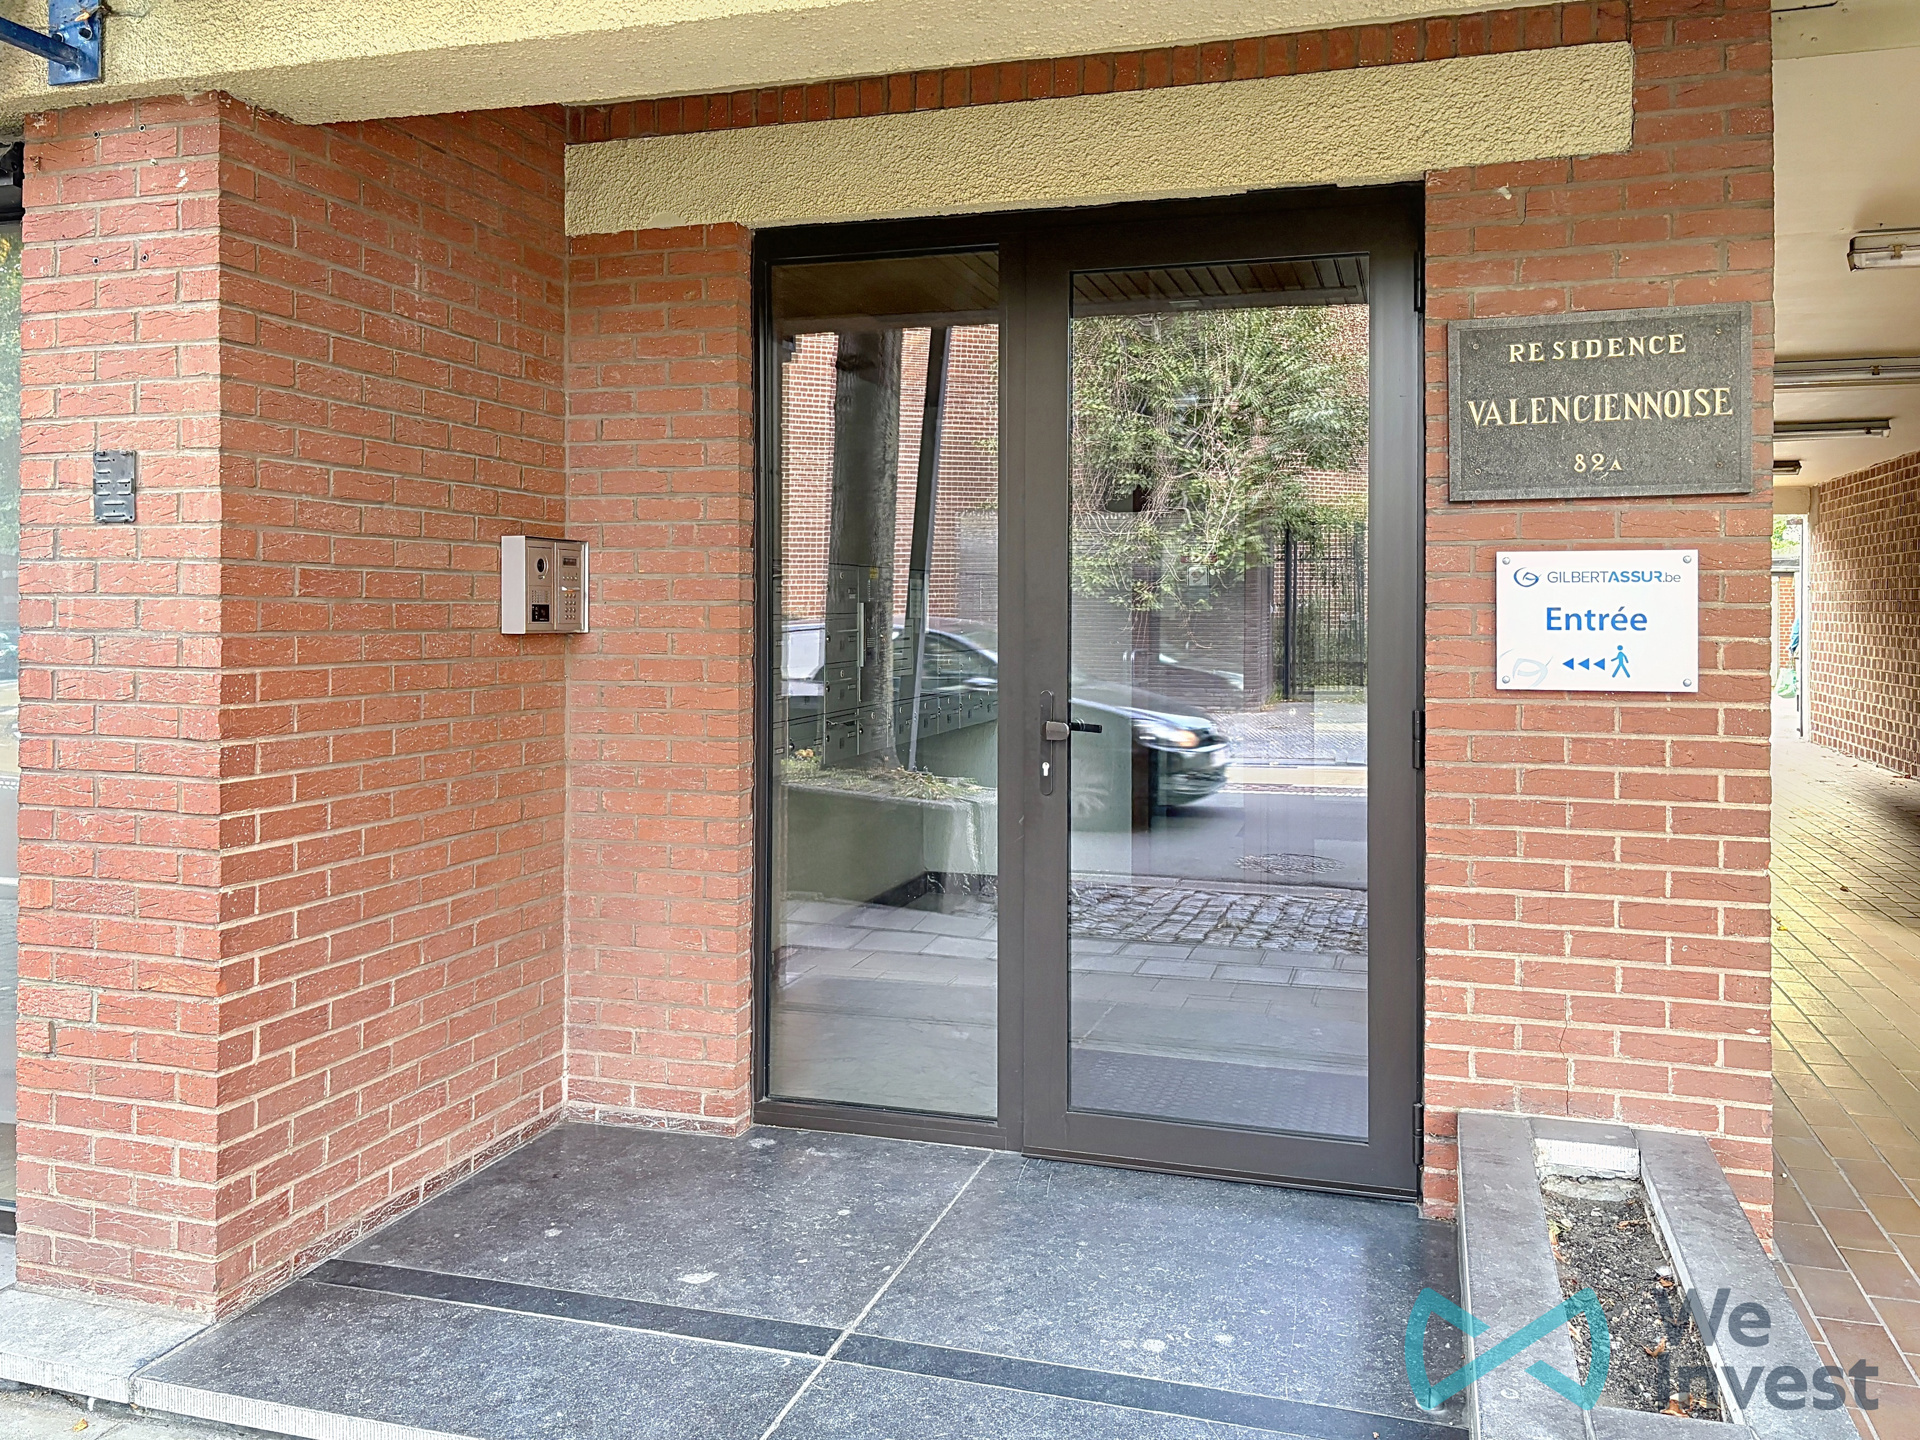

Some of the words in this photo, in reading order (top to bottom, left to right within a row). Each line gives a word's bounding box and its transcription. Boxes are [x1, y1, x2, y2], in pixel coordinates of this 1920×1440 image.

[1509, 333, 1686, 362] RESIDENCE
[1467, 387, 1733, 427] VALENCIENNOISE
[1573, 453, 1622, 473] 82A
[1547, 570, 1681, 583] GILBERTASSUR.be
[1546, 606, 1647, 631] Entrée
